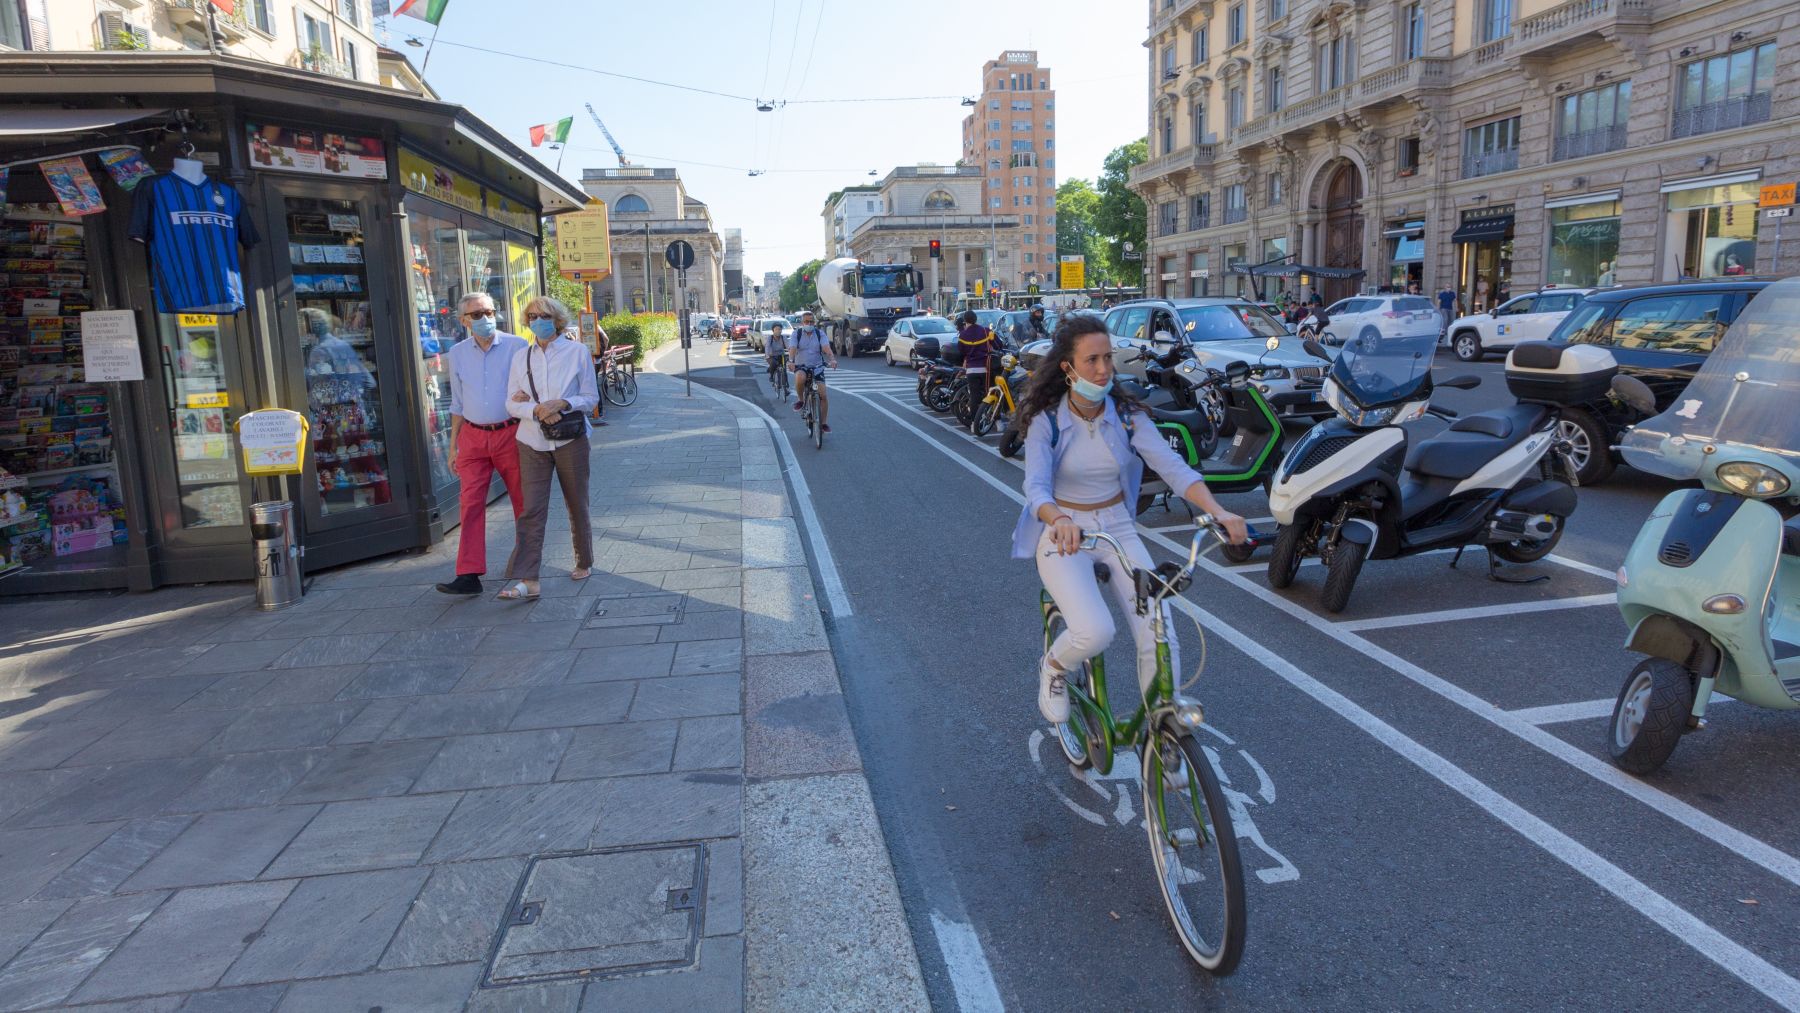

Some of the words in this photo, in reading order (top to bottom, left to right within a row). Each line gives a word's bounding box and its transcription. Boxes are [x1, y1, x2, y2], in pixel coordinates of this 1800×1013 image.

[442, 190, 454, 202] PER
[455, 196, 474, 210] ADULTI
[1762, 189, 1795, 201] TAXI
[1465, 206, 1514, 219] ALBANO
[169, 210, 234, 229] PIRELLI
[1169, 435, 1179, 448] lt
